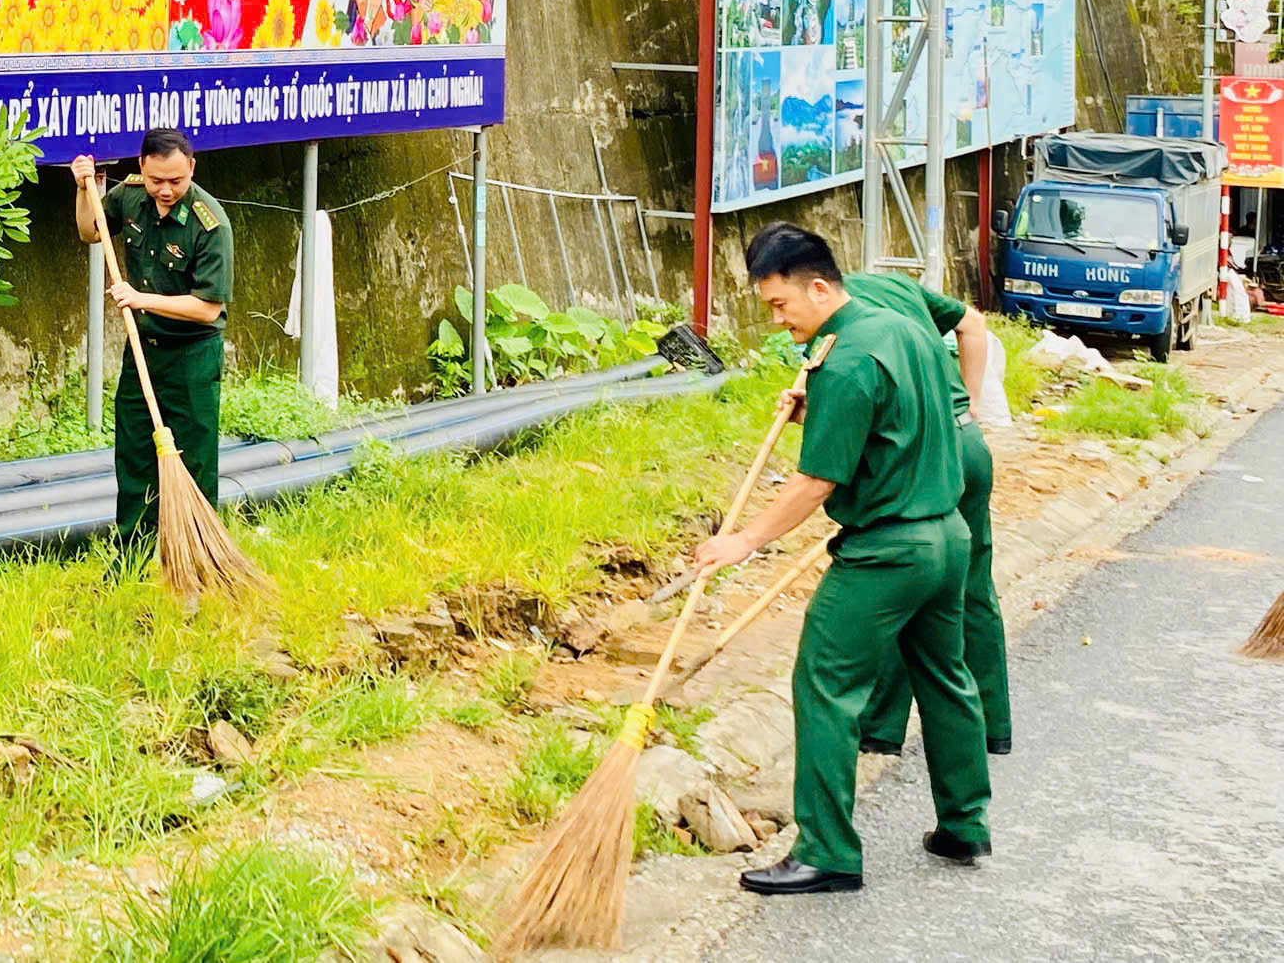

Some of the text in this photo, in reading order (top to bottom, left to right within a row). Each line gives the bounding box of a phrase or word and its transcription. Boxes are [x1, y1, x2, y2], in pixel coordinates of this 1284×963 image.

[37, 88, 71, 138] XÂY
[76, 90, 121, 143] DỰNG
[125, 85, 145, 132] VÀ
[149, 75, 179, 129] BẢO
[183, 82, 201, 135] VỆ
[205, 80, 241, 126] VỮNG
[244, 74, 279, 123] CHẮC
[282, 71, 299, 120] TỔ
[301, 71, 333, 123] QUỐC
[336, 75, 360, 123] VIỆT
[362, 80, 389, 114] NAM
[390, 73, 405, 112] XÃ
[407, 72, 426, 117] HỘI
[428, 64, 448, 109] CHỦ
[450, 70, 484, 108] NGHĨA!
